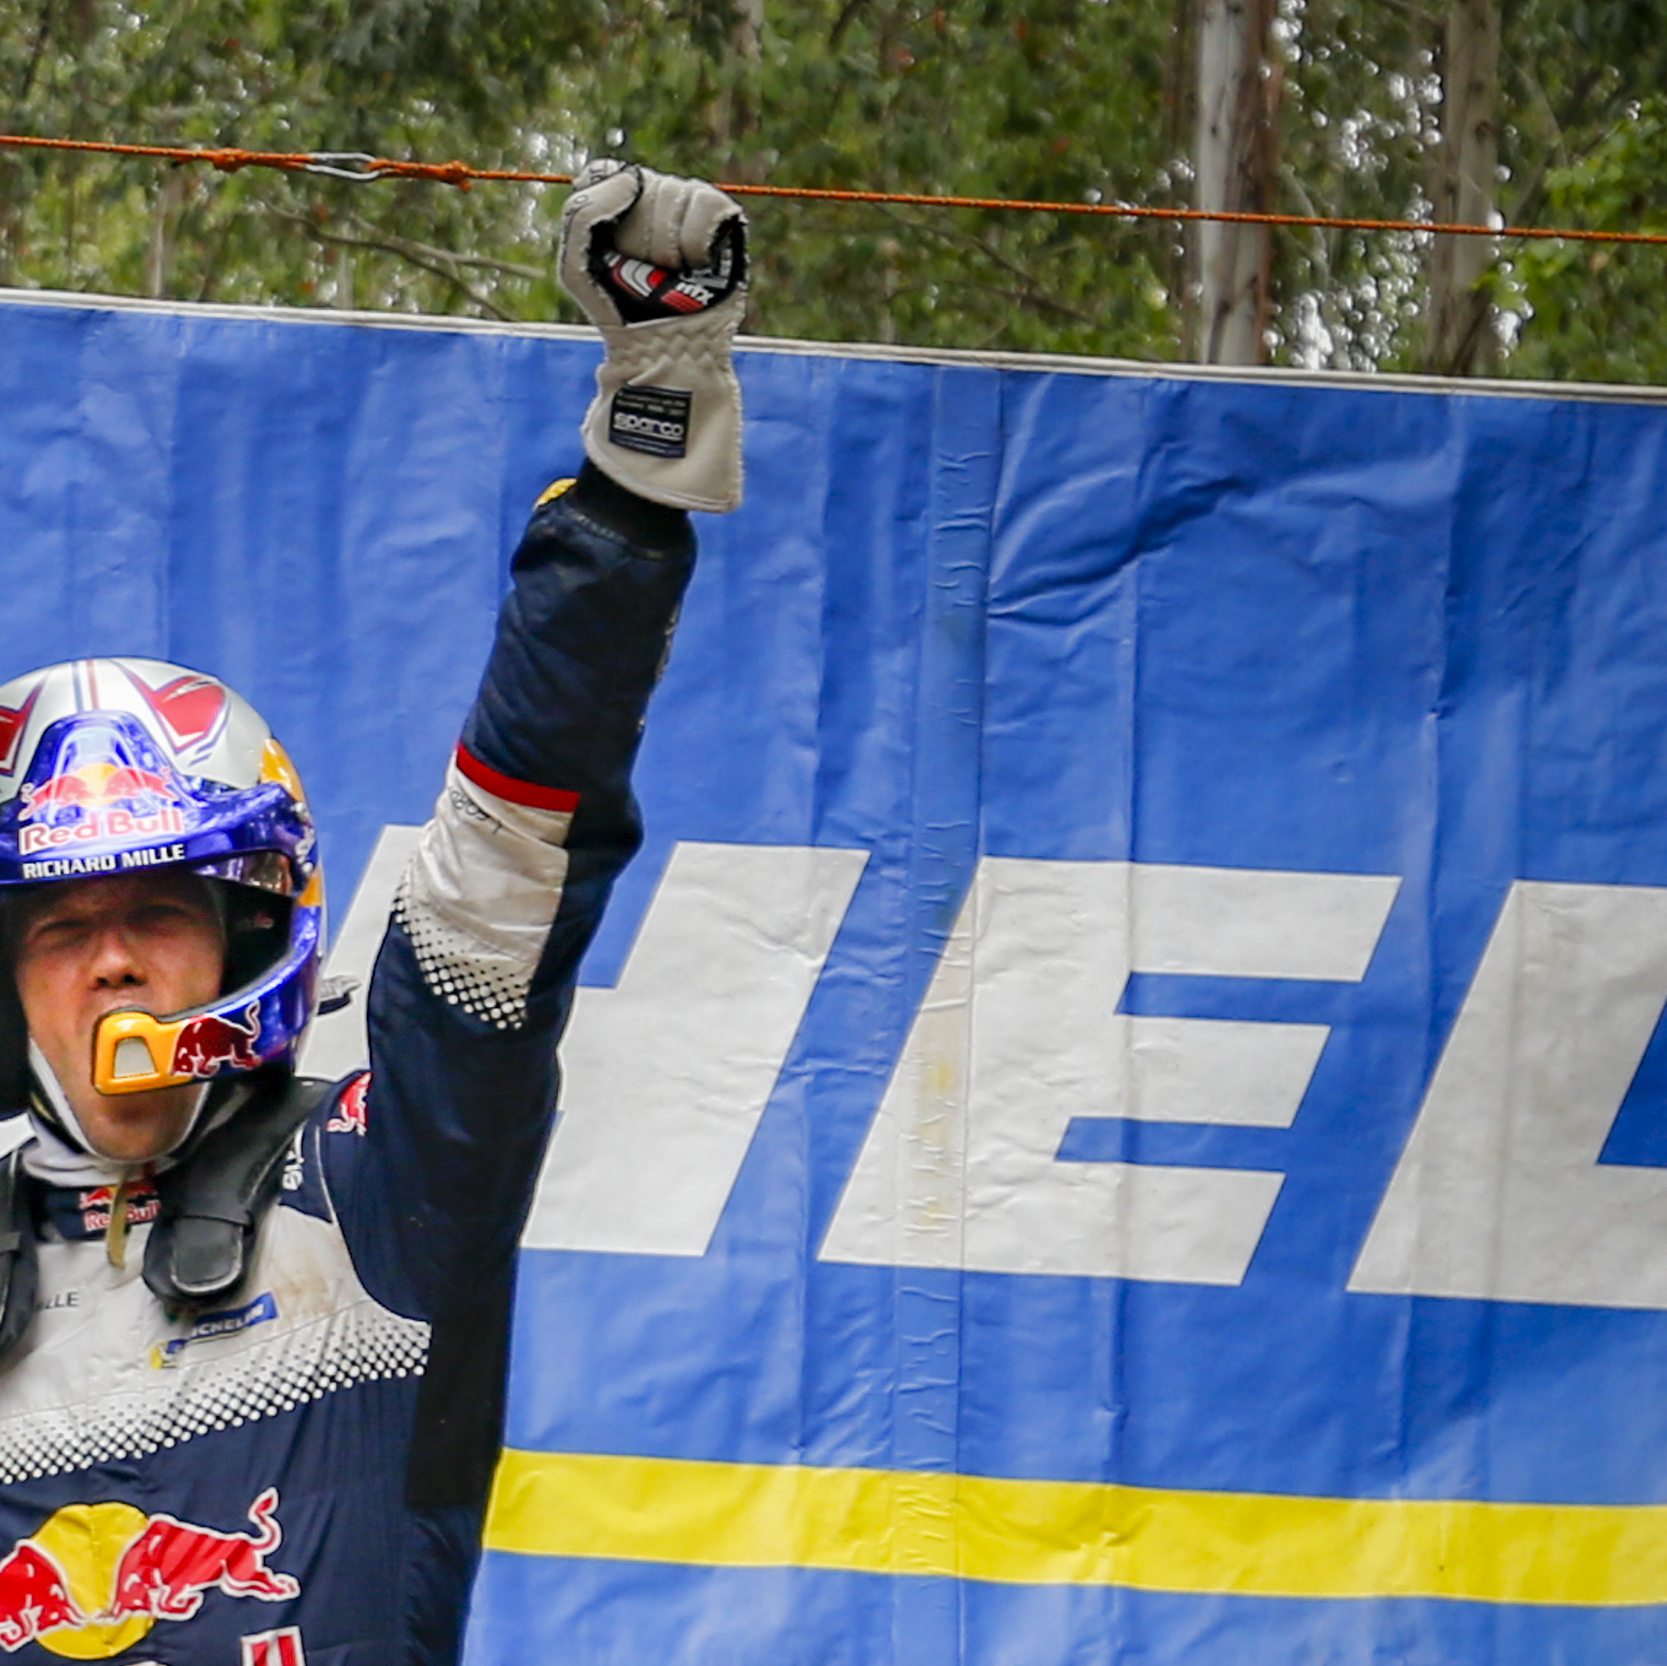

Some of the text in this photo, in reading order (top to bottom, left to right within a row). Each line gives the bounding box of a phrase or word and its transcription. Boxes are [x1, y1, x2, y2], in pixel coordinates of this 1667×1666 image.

[19, 806, 186, 856] Red Bull
[22, 843, 186, 880] RICHARD MILLE
